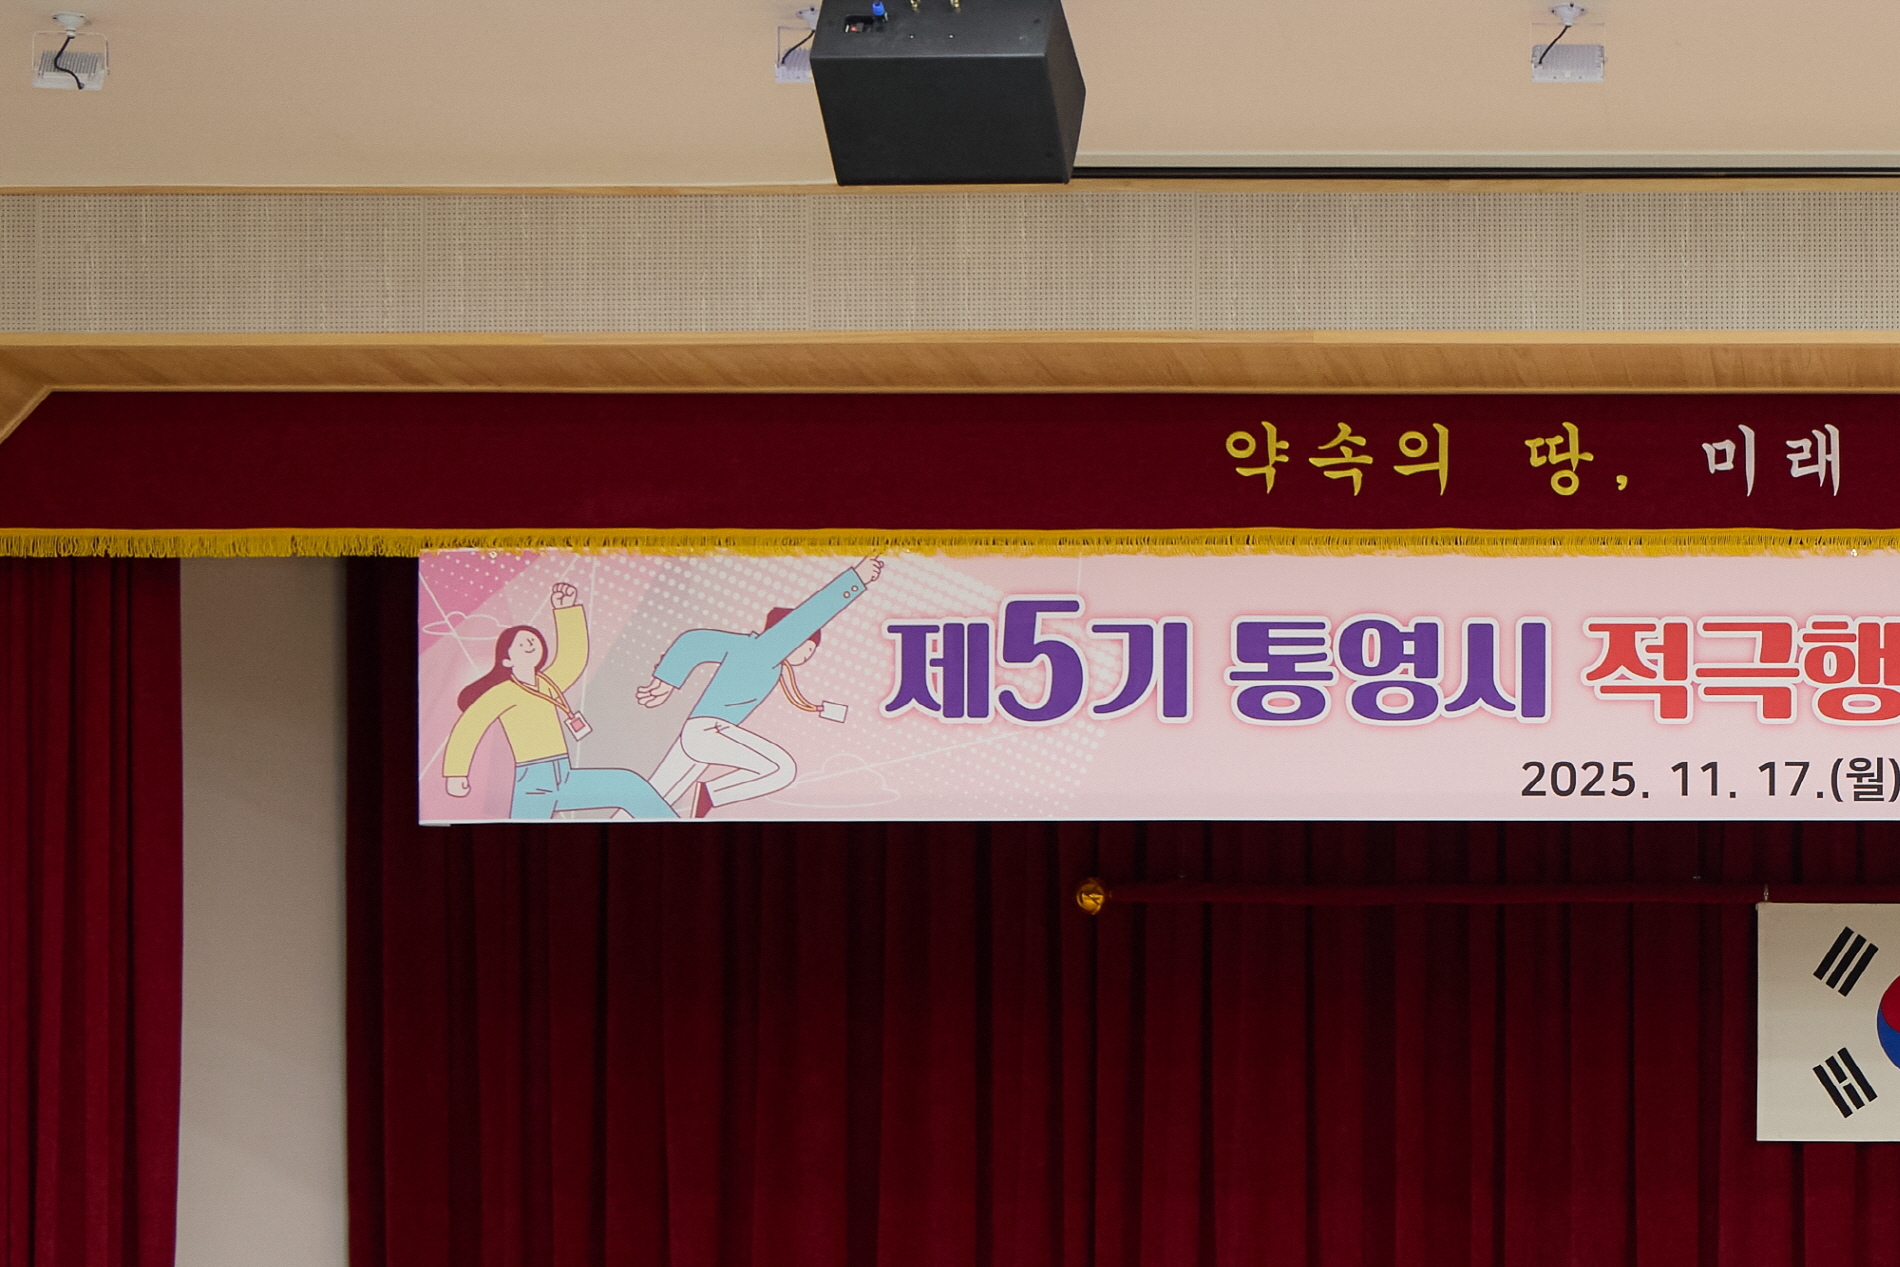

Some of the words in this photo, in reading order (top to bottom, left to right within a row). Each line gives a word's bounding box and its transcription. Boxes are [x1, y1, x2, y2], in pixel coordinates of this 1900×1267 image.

[1225, 422, 1449, 497] 약속의
[1525, 422, 1628, 496] 땅,
[1702, 424, 1840, 497] 미래
[885, 599, 1188, 722] 제5기
[1229, 618, 1547, 722] 통영시
[1522, 761, 1649, 799] 2025.
[1671, 761, 1736, 799] 11.
[1758, 757, 1900, 803] 17.(월)
